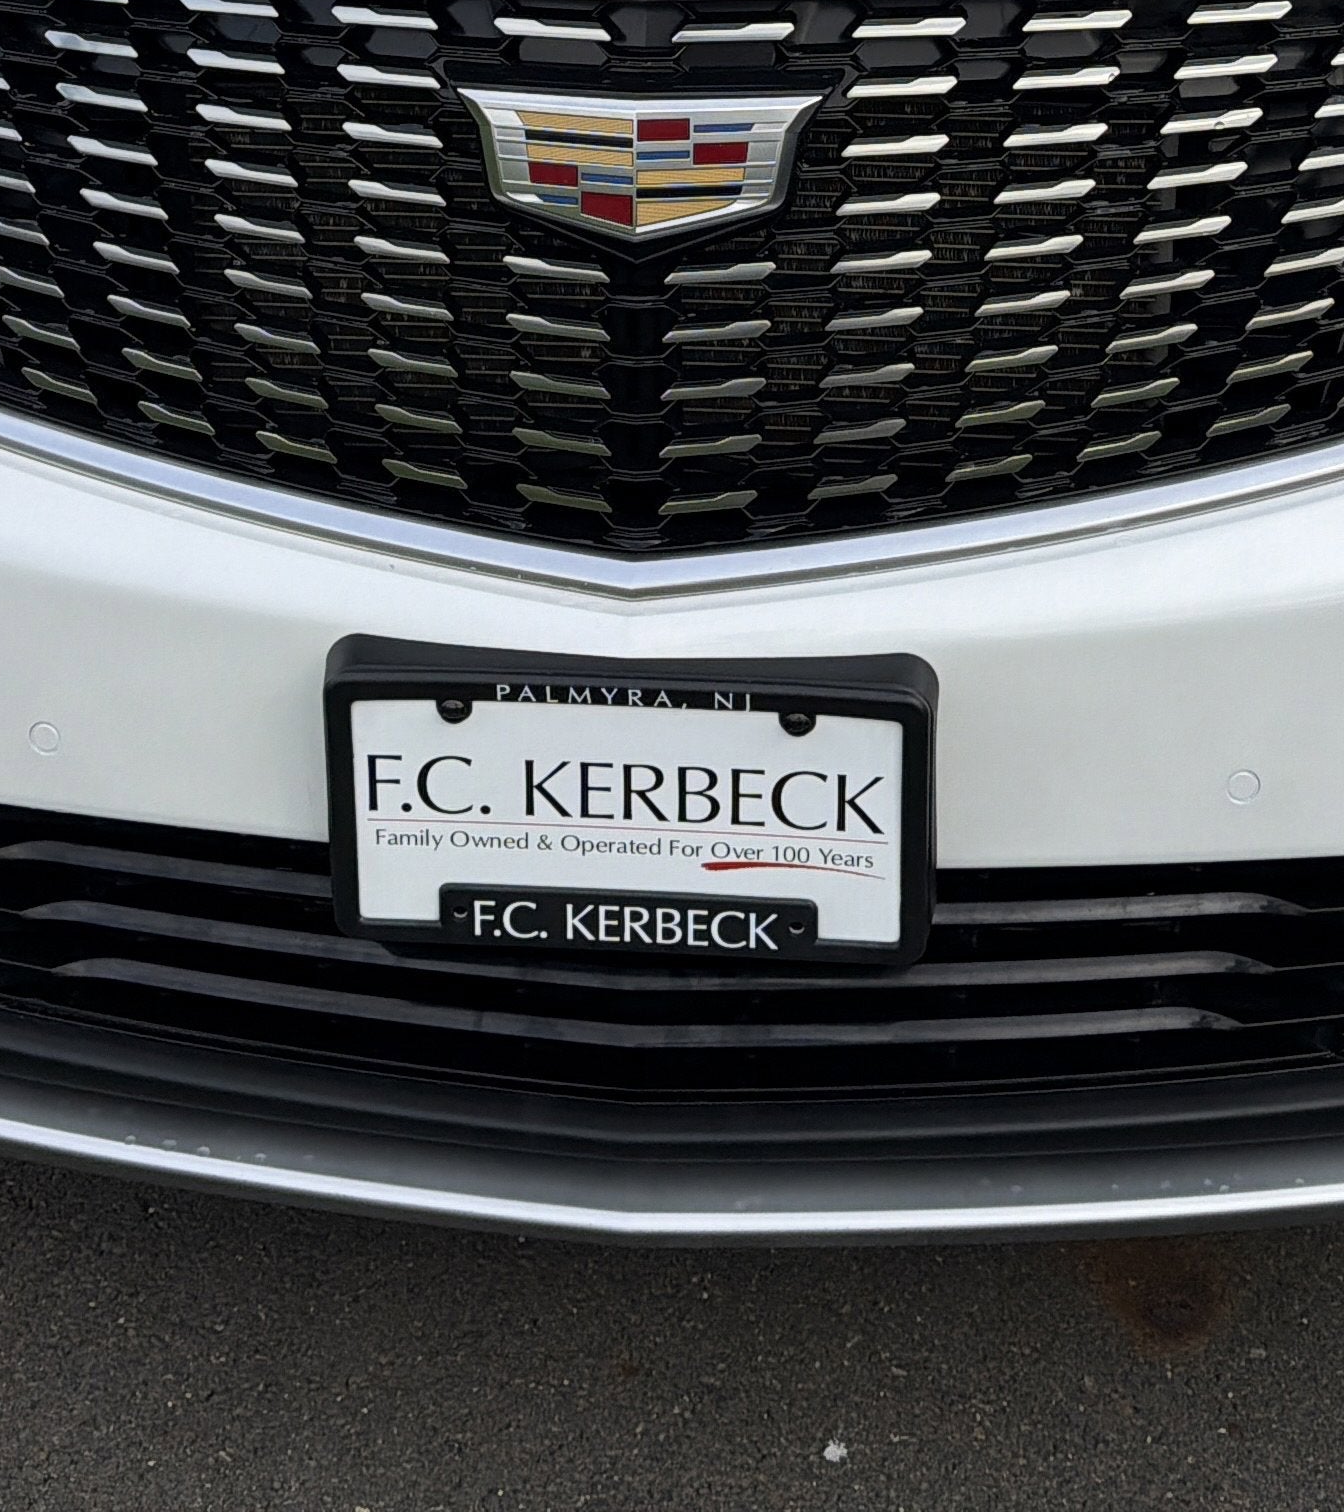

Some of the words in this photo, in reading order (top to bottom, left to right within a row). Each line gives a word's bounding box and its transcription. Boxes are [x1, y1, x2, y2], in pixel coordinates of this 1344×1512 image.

[366, 753, 492, 816] F.C.
[523, 758, 886, 835] KERBECK
[375, 828, 443, 851] Family
[450, 830, 529, 850] Owned
[536, 834, 553, 850] &
[560, 834, 662, 856] Operated
[669, 839, 703, 858] For
[711, 841, 764, 861] Over
[772, 845, 811, 863] 100
[819, 847, 874, 868] Years
[473, 900, 549, 939] F.C.
[566, 903, 779, 950] KERBECK
